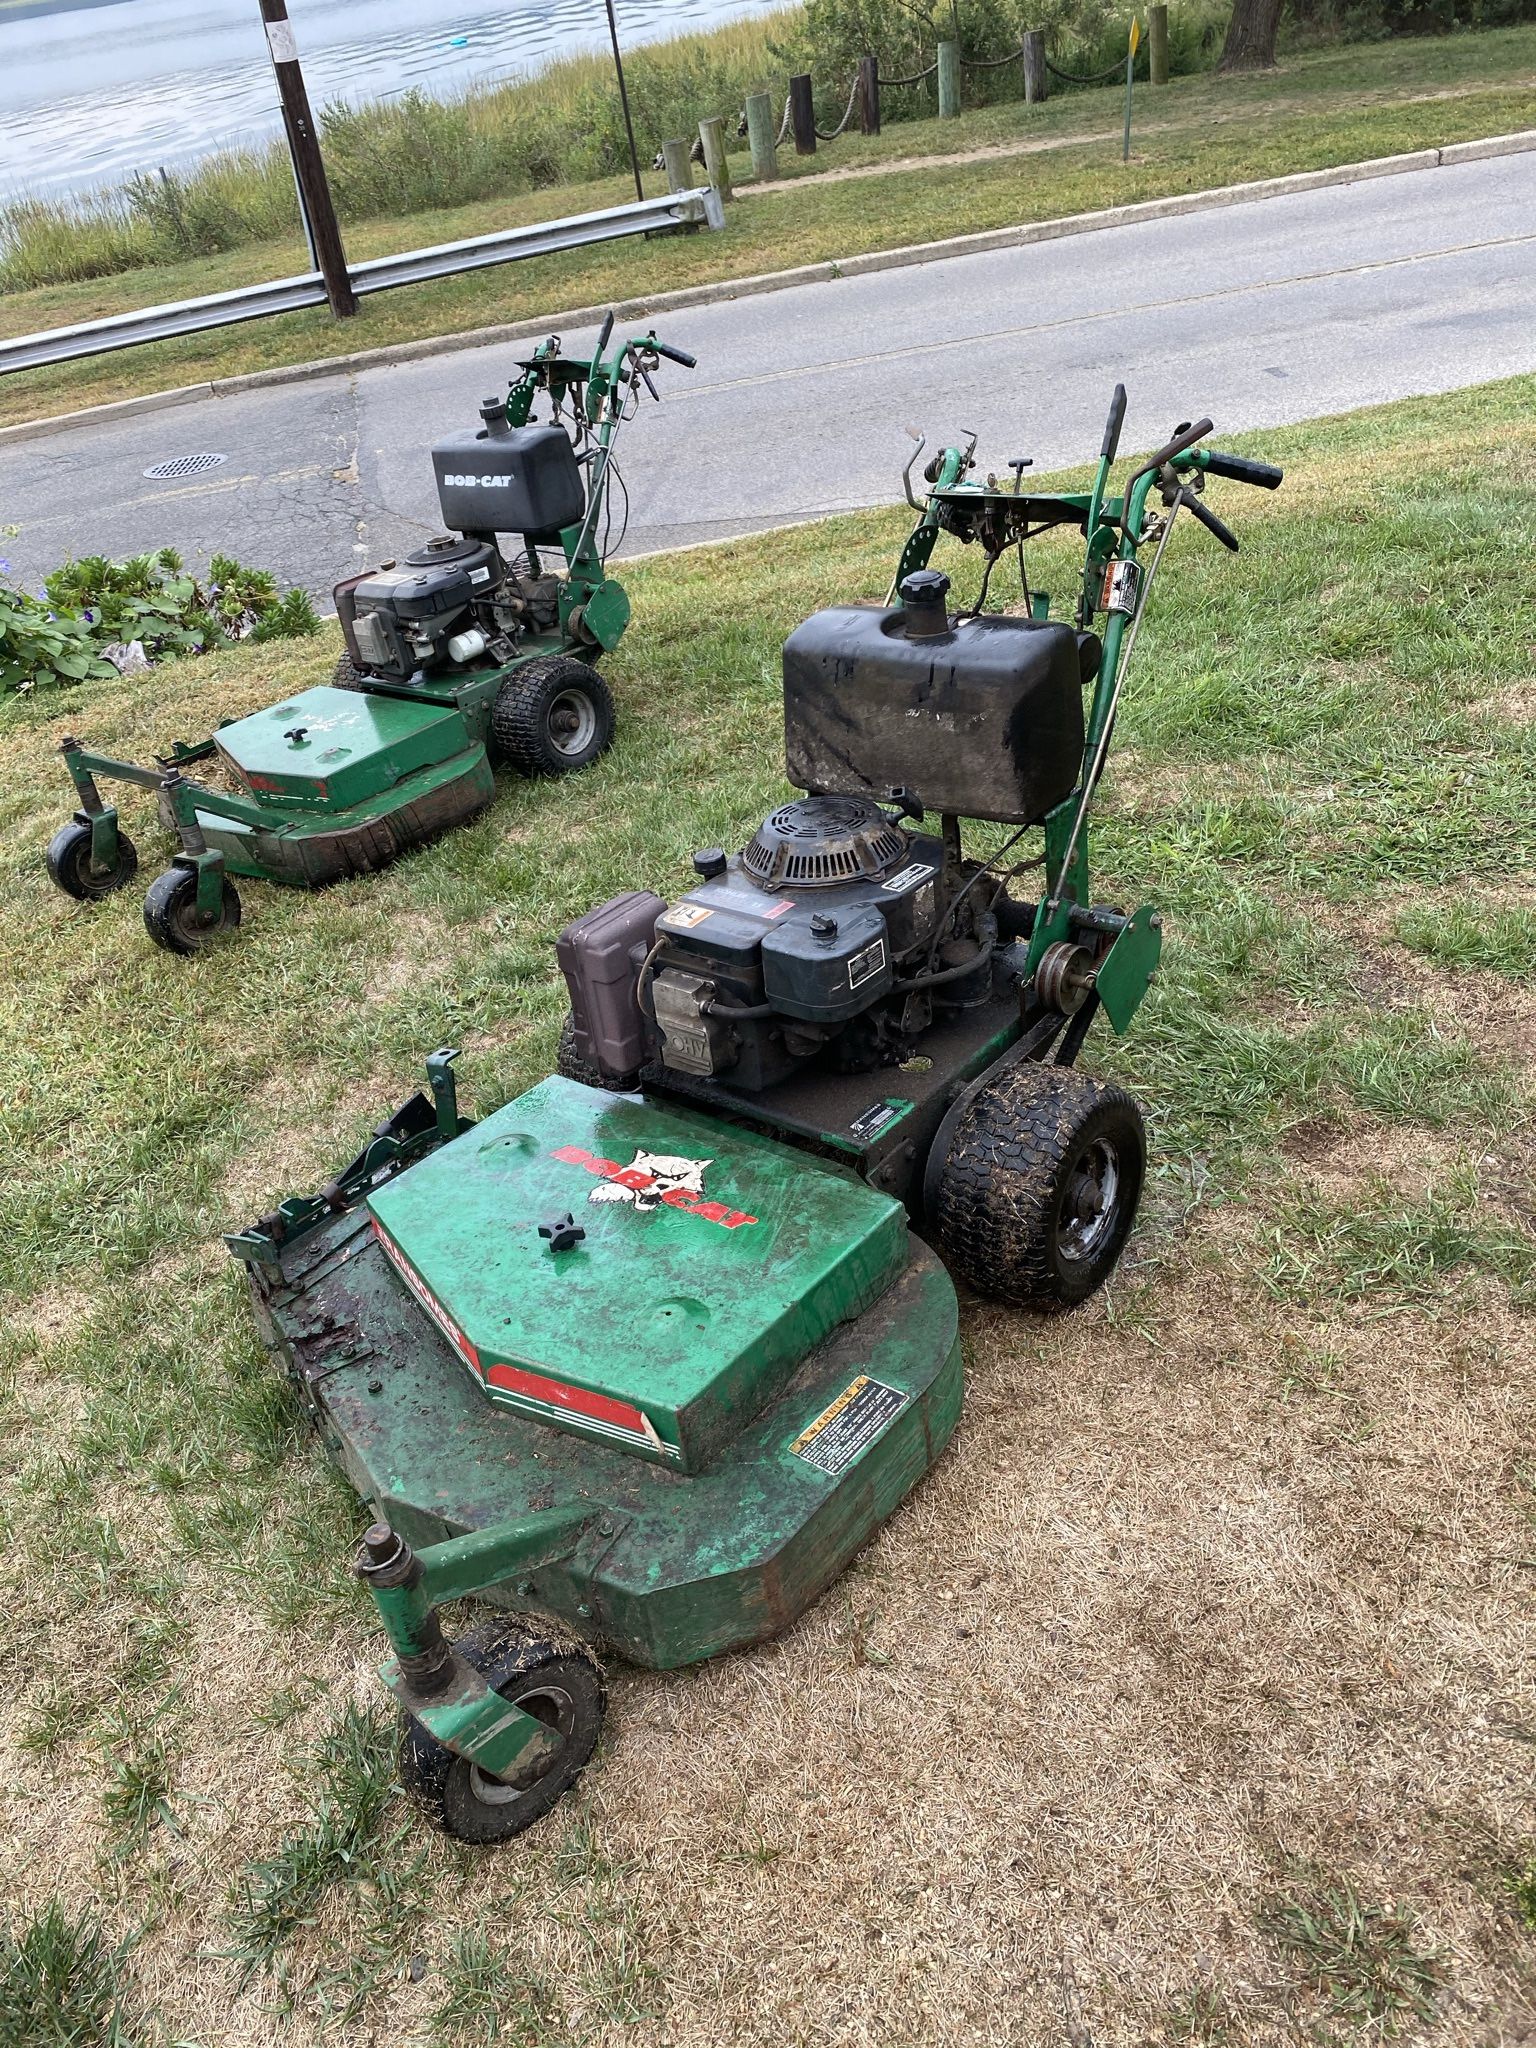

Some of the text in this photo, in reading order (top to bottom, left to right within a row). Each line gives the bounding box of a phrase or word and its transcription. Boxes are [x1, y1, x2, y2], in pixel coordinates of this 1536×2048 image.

[444, 474, 511, 487] BOB-CAT
[671, 1036, 706, 1059] OHV
[809, 1393, 853, 1435] WARNING
